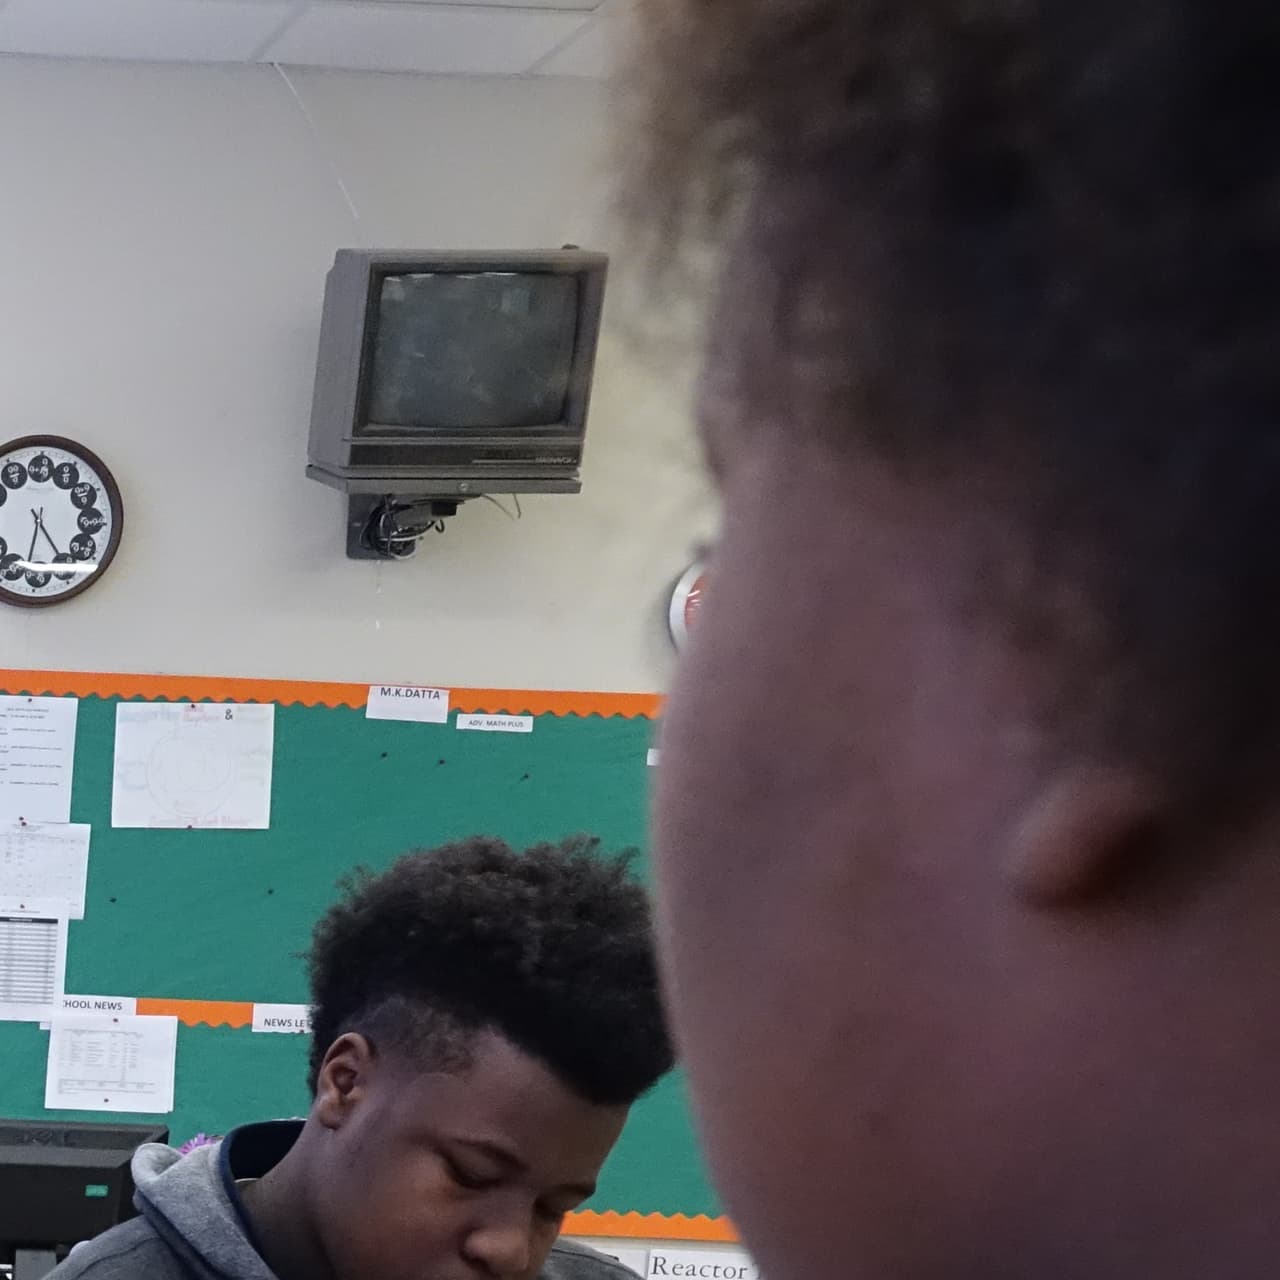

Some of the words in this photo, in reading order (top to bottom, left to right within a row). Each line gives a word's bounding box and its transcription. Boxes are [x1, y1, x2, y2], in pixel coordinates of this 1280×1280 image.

[380, 687, 440, 700] M.K.DATTA
[94, 1001, 122, 1011] NEWS
[263, 1018, 293, 1028] NEWS
[650, 1255, 748, 1280] Reactor
